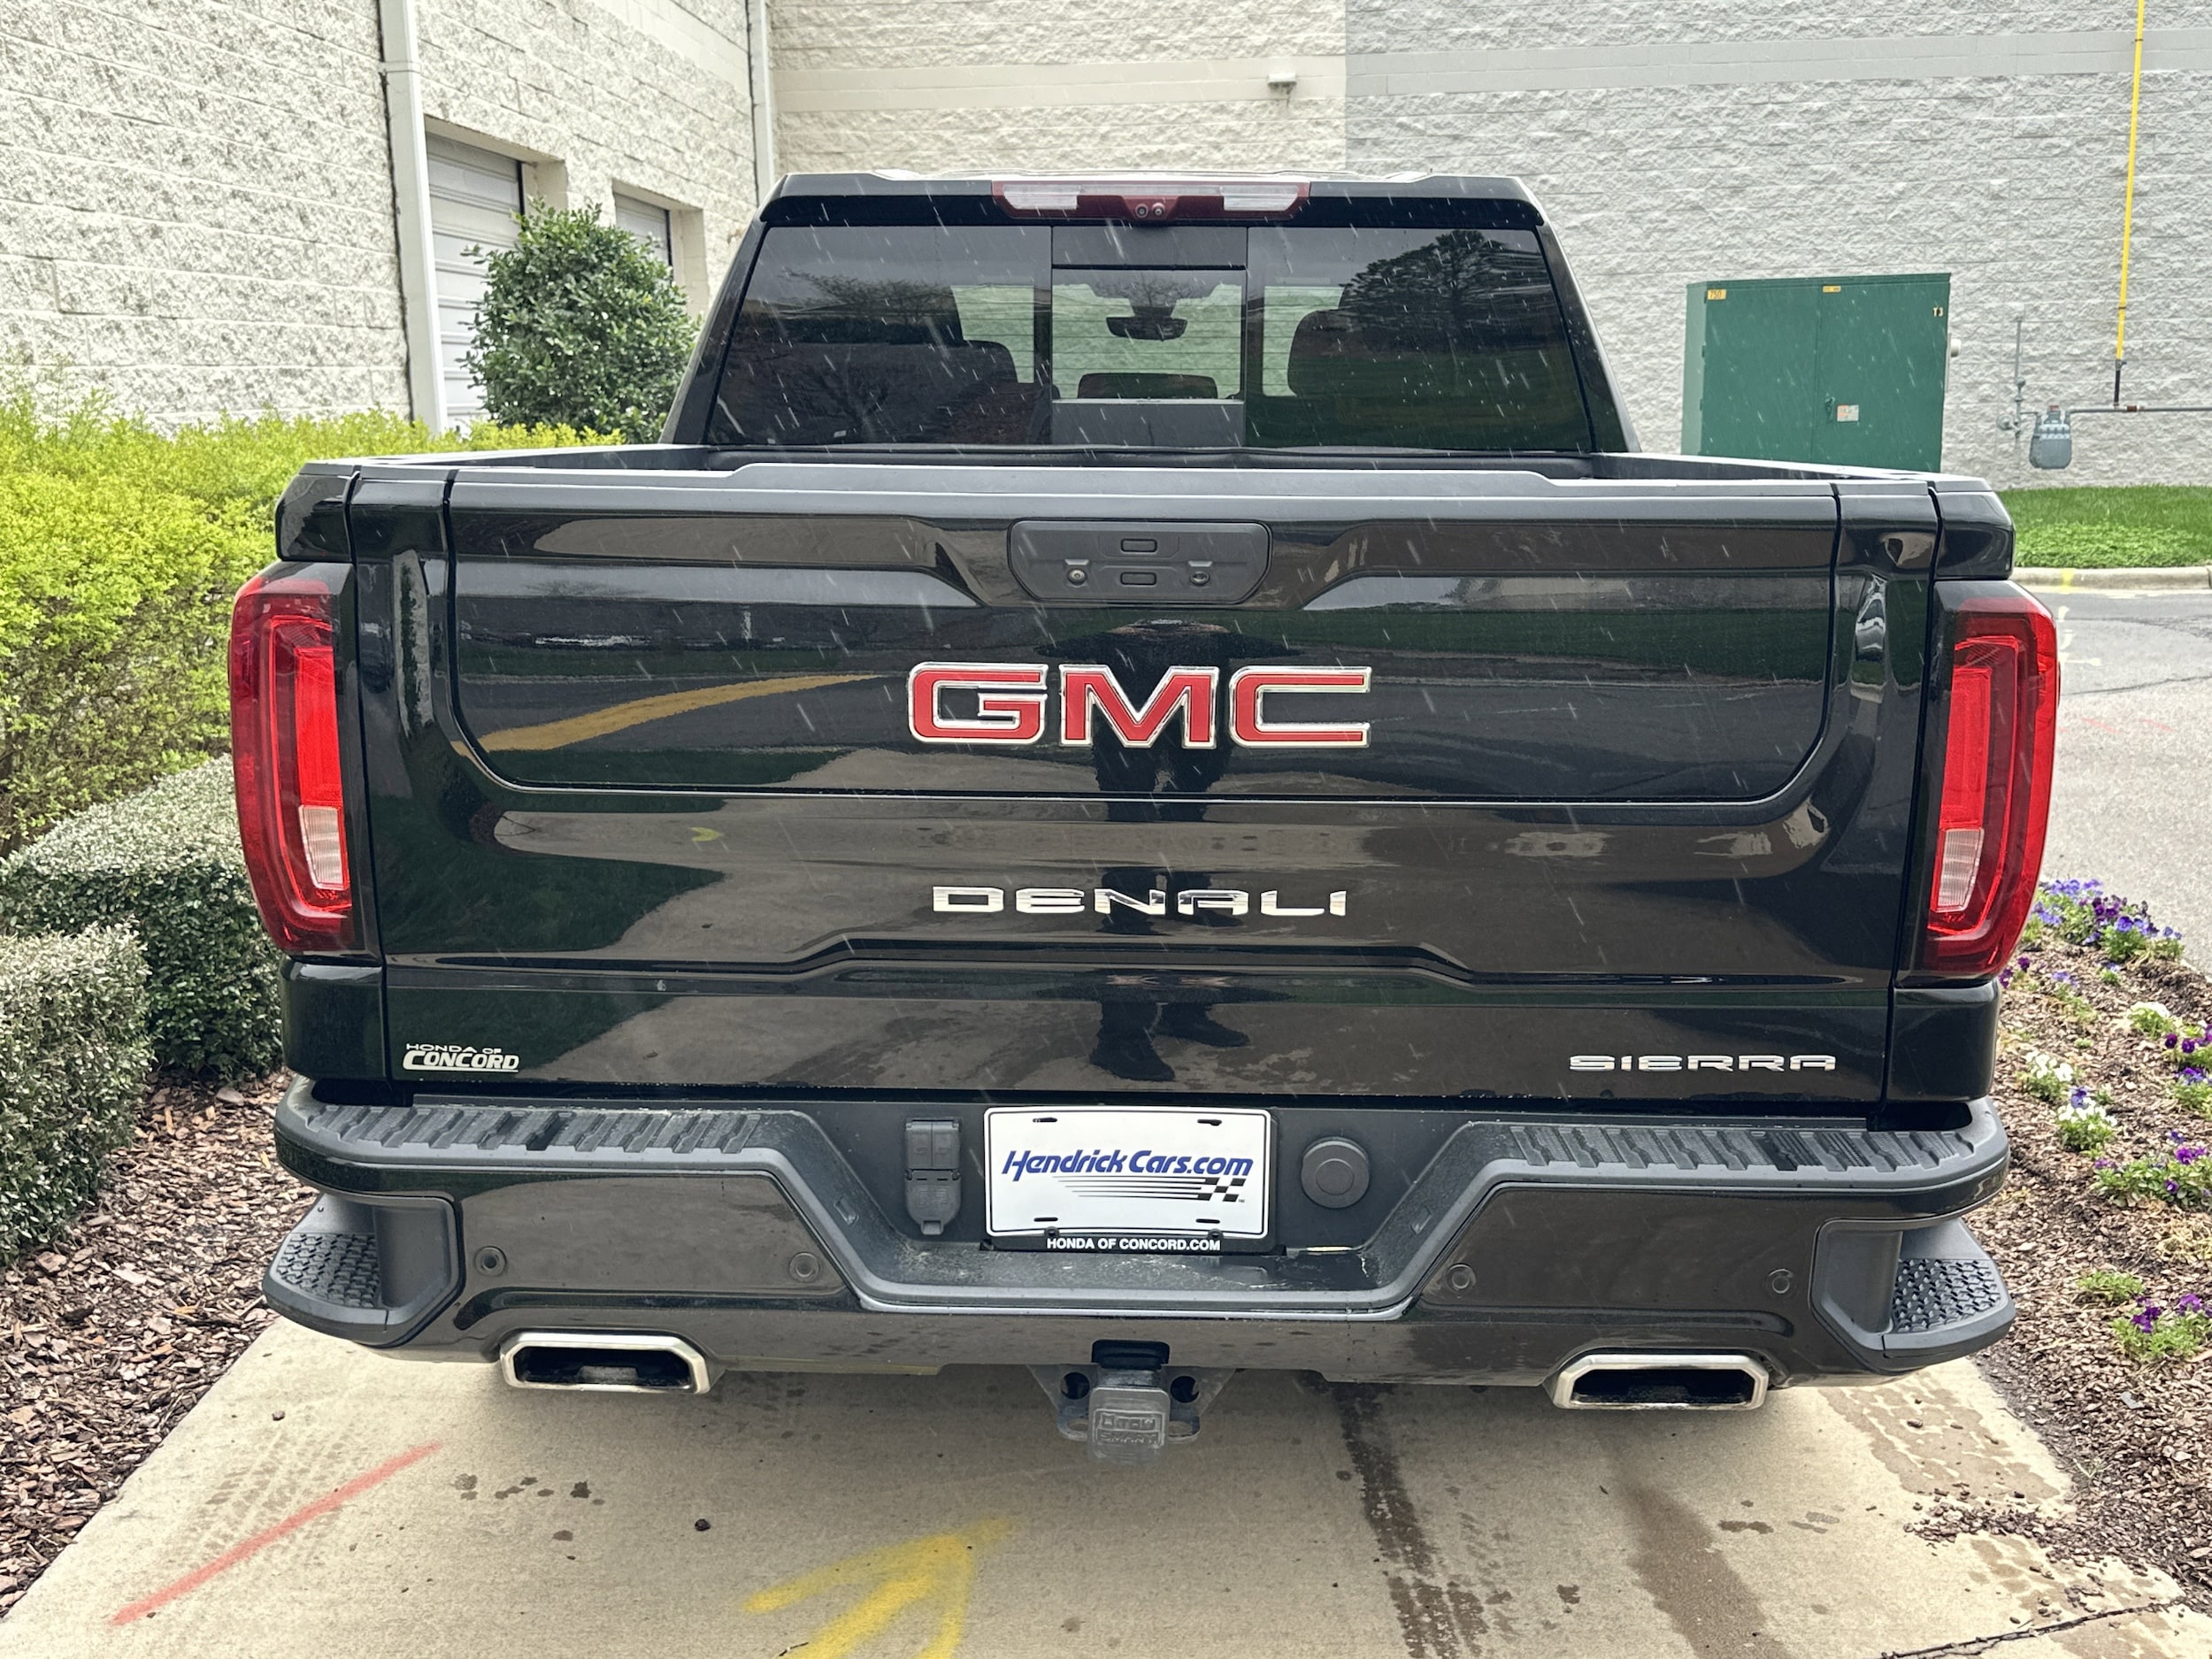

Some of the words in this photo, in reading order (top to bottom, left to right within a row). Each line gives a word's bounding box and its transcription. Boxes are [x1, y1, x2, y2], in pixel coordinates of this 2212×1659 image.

[908, 662, 1372, 749] GMC
[933, 886, 1347, 917] DENALI
[406, 1043, 477, 1053] HONDA
[403, 1050, 519, 1072] CONCORD
[1570, 1055, 1836, 1072] SIERRA
[1047, 1238, 1095, 1249] HONDA
[1098, 1239, 1117, 1249] OF
[1119, 1239, 1221, 1251] CONCORD.COM
